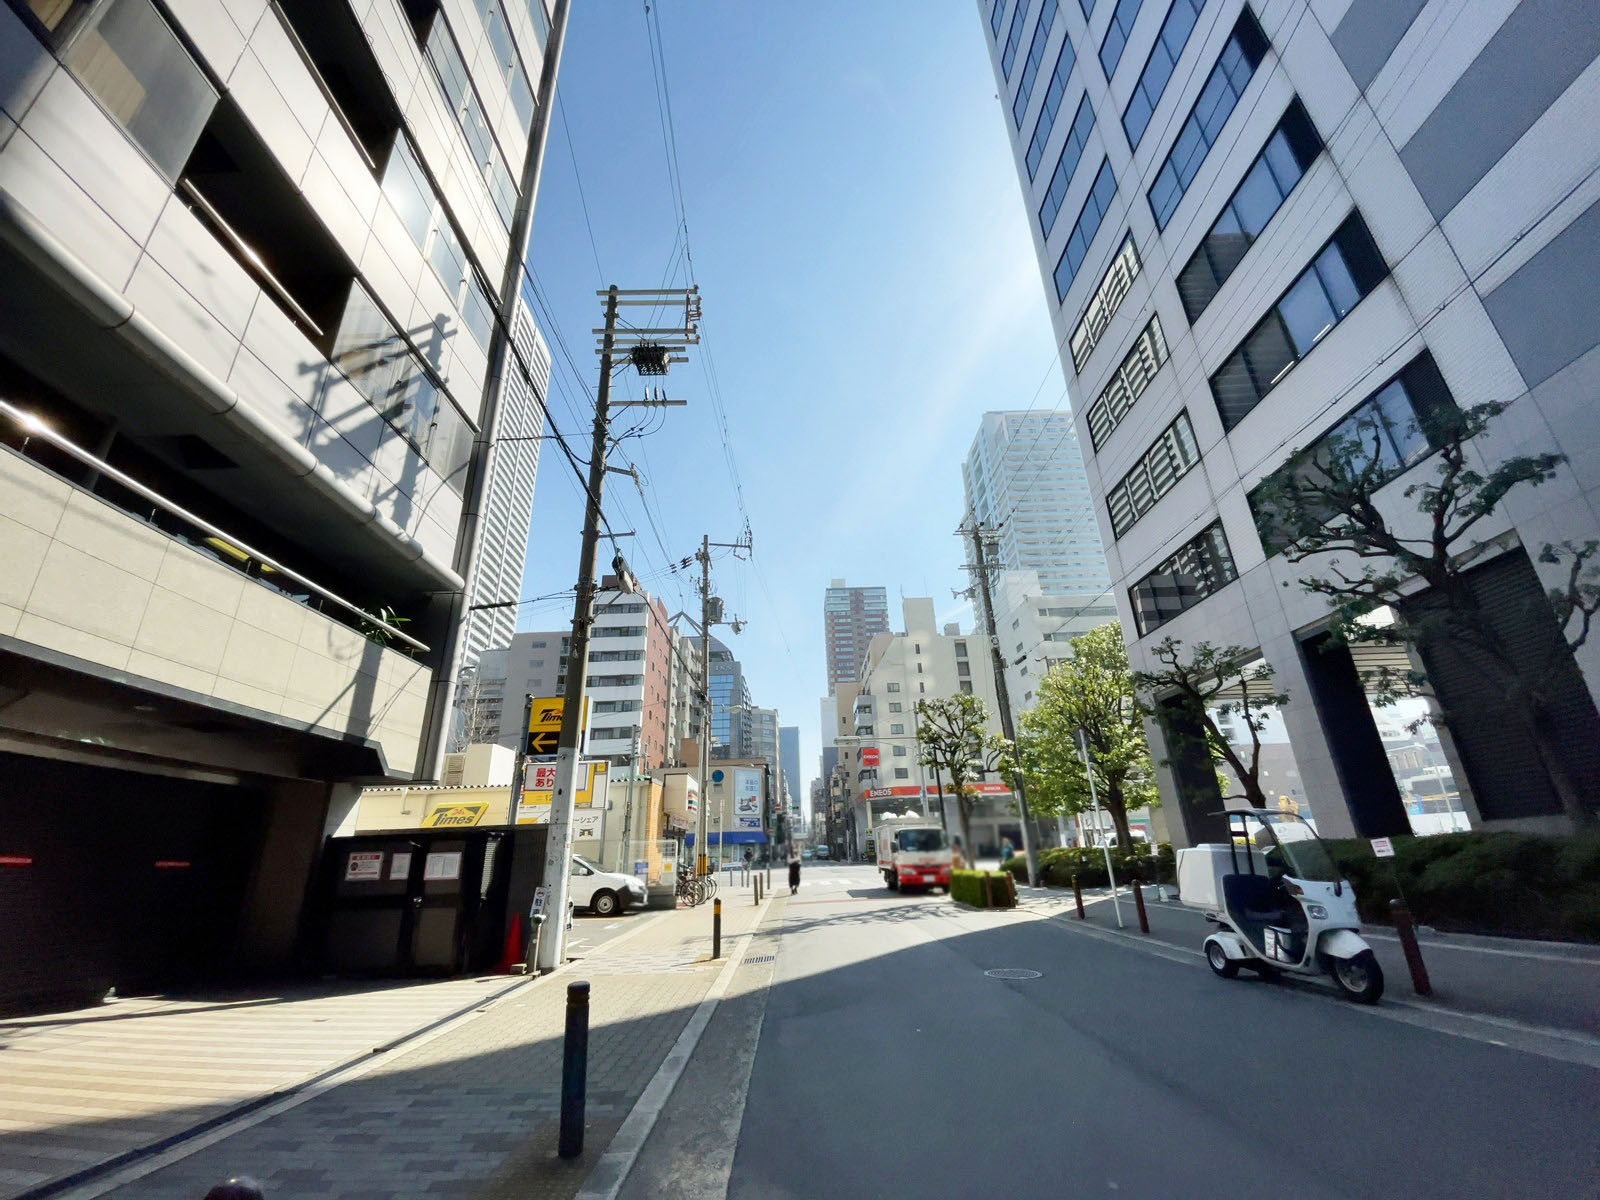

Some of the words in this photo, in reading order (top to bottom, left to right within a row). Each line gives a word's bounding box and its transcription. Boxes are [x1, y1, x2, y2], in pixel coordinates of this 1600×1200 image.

[536, 767, 556, 777] 最大
[535, 778, 554, 788] あり
[870, 788, 892, 797] ENEOS
[432, 808, 475, 826] Times
[573, 815, 599, 824] ーシェア
